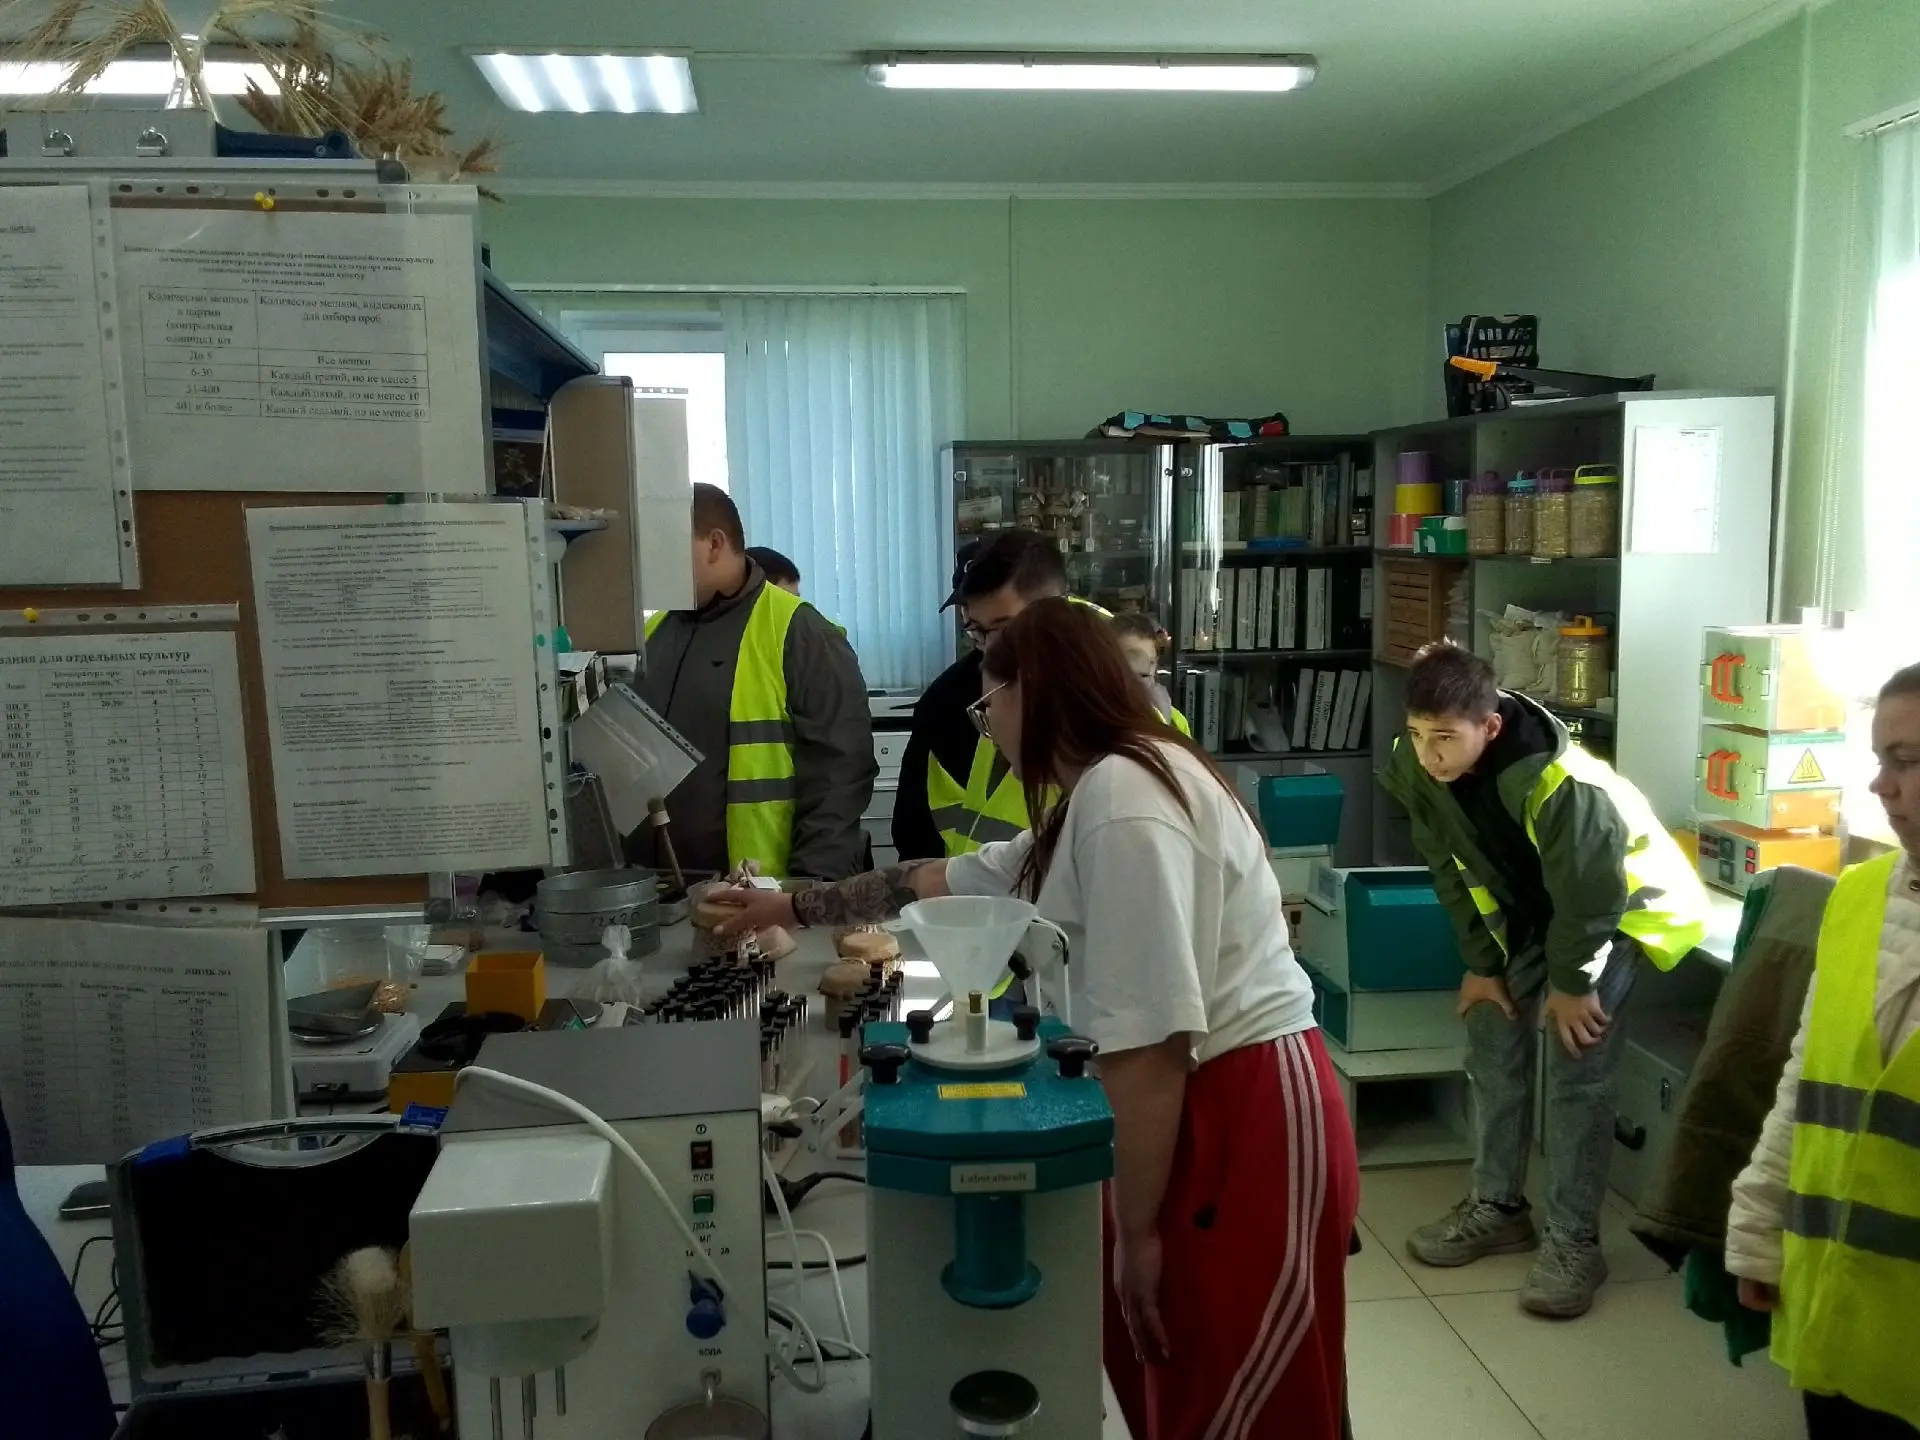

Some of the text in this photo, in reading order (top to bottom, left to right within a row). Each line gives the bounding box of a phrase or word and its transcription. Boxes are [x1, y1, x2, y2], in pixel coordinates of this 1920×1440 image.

[148, 291, 249, 304] Количество мешков
[259, 295, 317, 307] Количество
[320, 299, 361, 310] мешков,
[185, 309, 221, 318] партии
[303, 311, 382, 326] для отбора проб
[190, 350, 213, 361] До 5
[317, 355, 371, 366] Все мешки
[191, 367, 213, 377] 6-30
[270, 370, 311, 381] Каждый
[352, 375, 364, 383] но
[380, 376, 409, 384] менее
[412, 375, 418, 384] 5
[185, 384, 220, 393] 31-400
[270, 386, 311, 397] Каждый
[349, 391, 361, 399] но
[363, 392, 375, 400] не
[377, 392, 405, 401] менее
[408, 391, 420, 401] 10
[204, 401, 233, 412] более
[266, 403, 306, 415] Каждый
[354, 408, 366, 416] но
[369, 408, 380, 416] не
[382, 408, 412, 417] менее
[39, 654, 64, 665] для
[66, 652, 136, 664] отдельных
[139, 650, 190, 662] культур
[693, 1173, 714, 1182] ПУСК
[692, 1221, 716, 1232] ДОЗА
[698, 1348, 722, 1356] ВОДА
